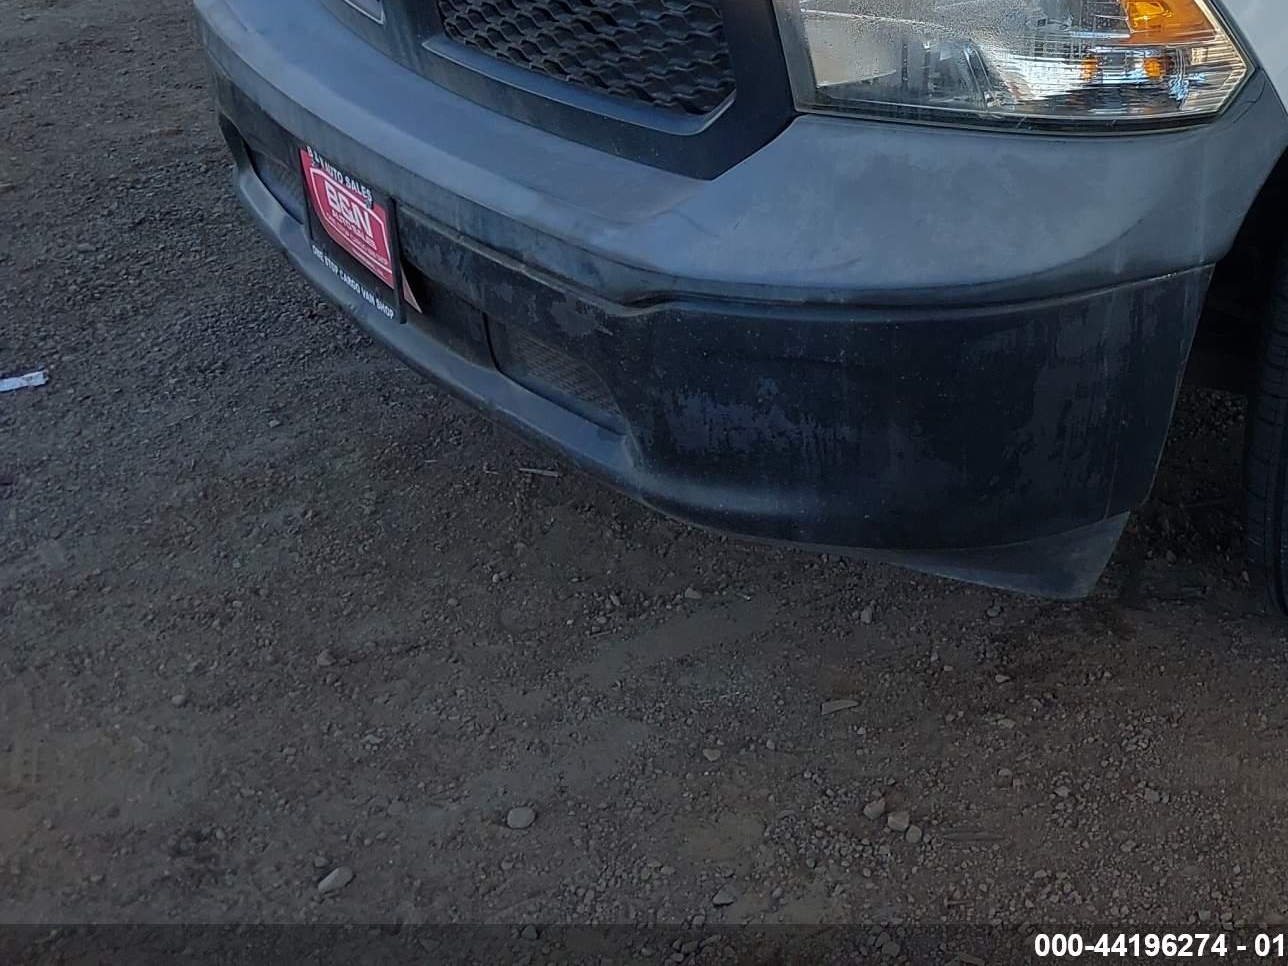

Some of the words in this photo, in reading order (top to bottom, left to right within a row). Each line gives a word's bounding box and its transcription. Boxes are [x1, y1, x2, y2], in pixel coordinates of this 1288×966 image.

[325, 161, 344, 184] AUTO
[345, 176, 373, 203] SALES
[324, 255, 338, 275] STOP
[340, 269, 361, 294] CARGO
[361, 286, 376, 306] VAN
[376, 297, 394, 320] SHOP
